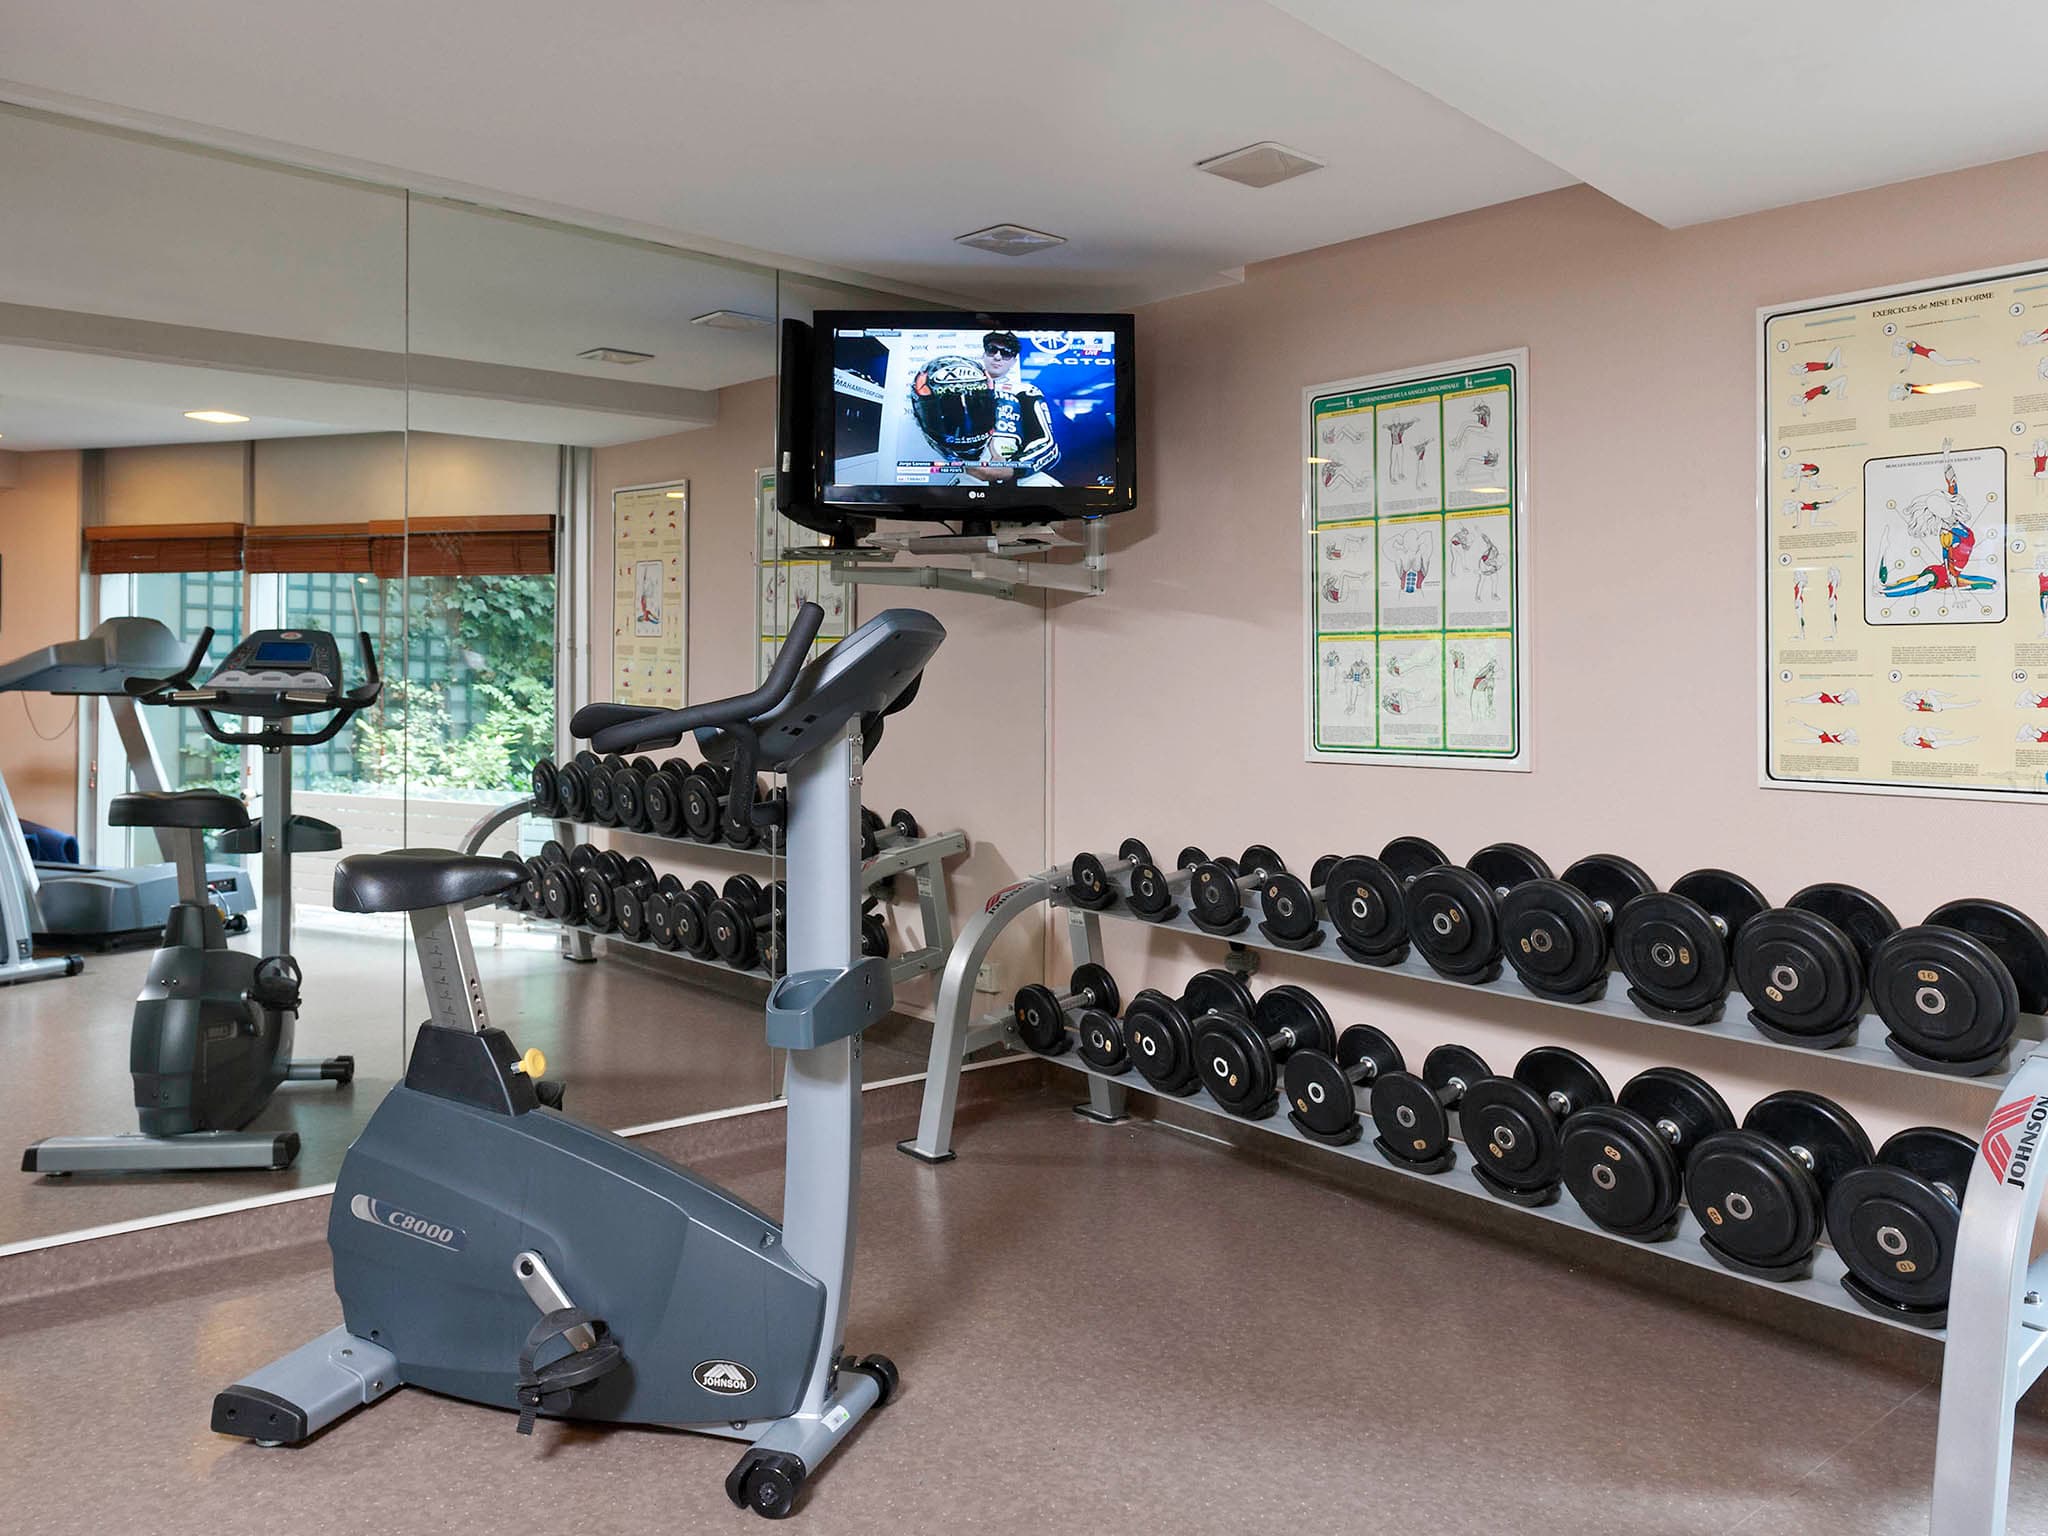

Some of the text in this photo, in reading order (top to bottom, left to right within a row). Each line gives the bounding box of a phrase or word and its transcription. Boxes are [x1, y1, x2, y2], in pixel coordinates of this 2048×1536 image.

[1872, 304, 1917, 318] EXERCICES
[1929, 299, 1950, 309] MISE
[1951, 297, 1963, 305] EN
[1964, 292, 1995, 303] FORME
[2007, 1096, 2048, 1190] JOHNSON
[388, 1211, 453, 1242] C8000
[702, 1376, 747, 1390] JOHNSON
